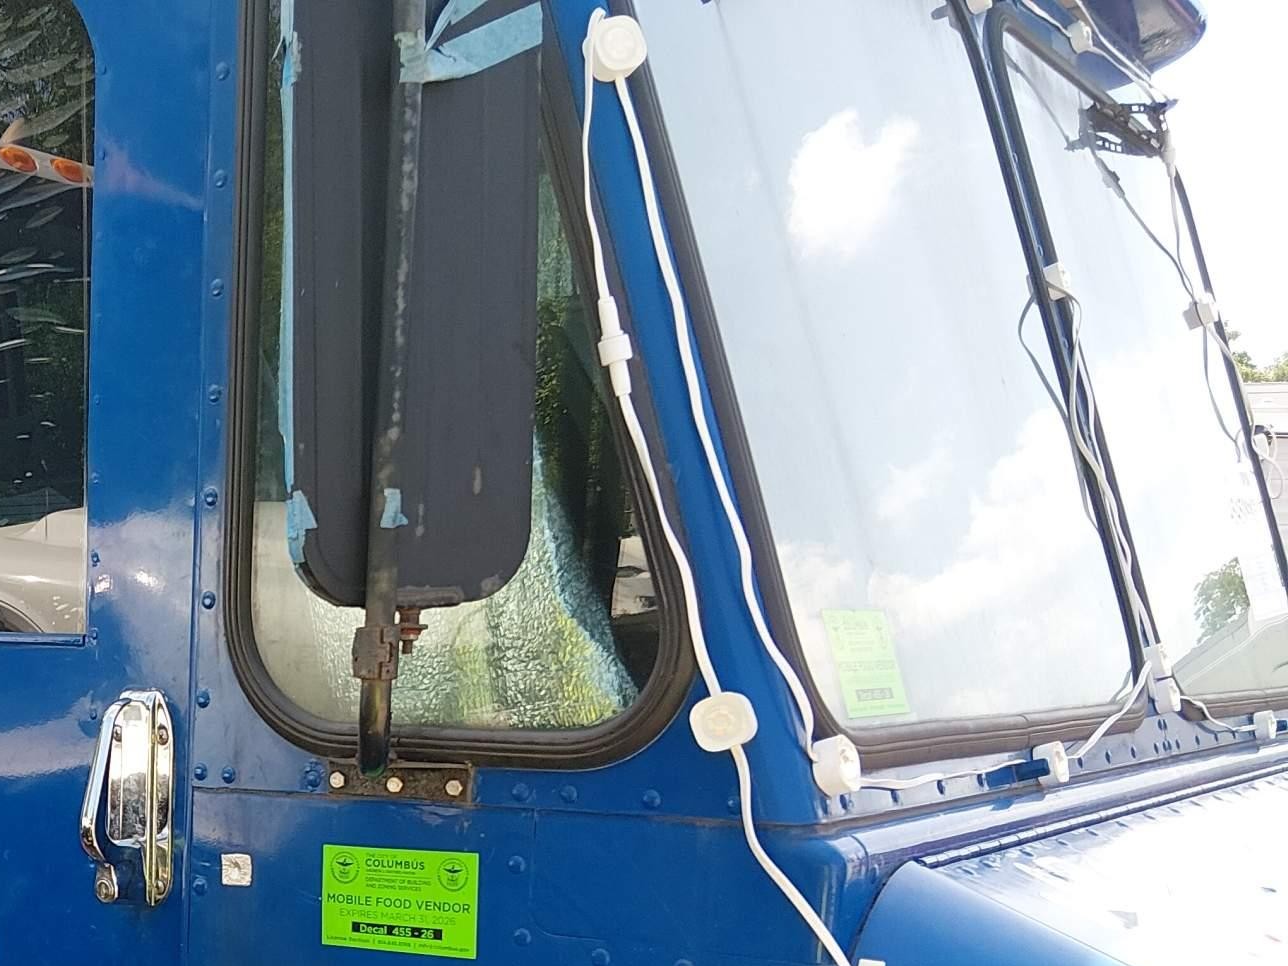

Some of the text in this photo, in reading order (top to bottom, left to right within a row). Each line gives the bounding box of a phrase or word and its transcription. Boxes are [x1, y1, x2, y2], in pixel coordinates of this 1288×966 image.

[364, 858, 425, 871] COLUMBUS
[327, 893, 471, 914] MOBILE FOOD VENDOR
[340, 908, 377, 919] EXPIRES
[380, 912, 415, 922] MARCH
[359, 923, 388, 935] Decal
[392, 926, 412, 937] 455
[420, 929, 435, 939] 26
